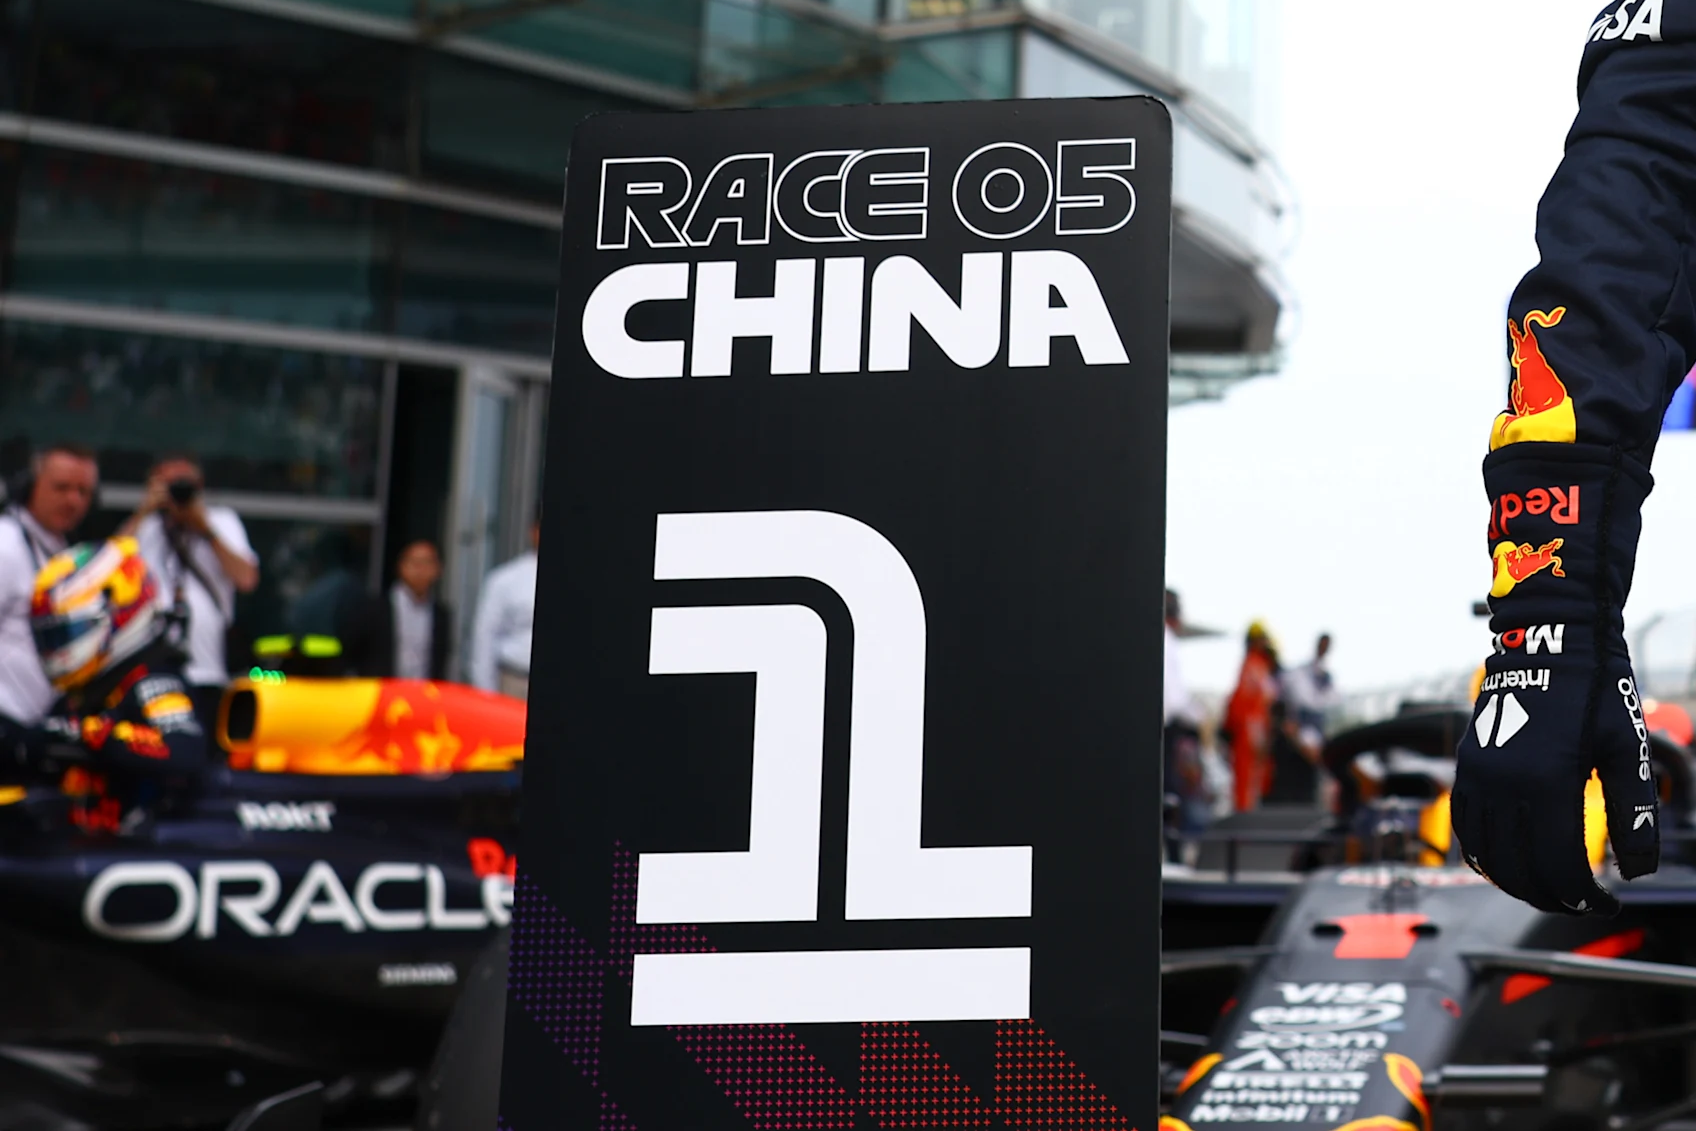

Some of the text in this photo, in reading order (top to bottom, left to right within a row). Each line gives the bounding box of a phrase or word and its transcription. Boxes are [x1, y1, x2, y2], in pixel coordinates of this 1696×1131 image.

[597, 137, 1137, 250] RACE 05
[581, 249, 1131, 380] CHINA
[630, 509, 1033, 1027] 1
[1618, 677, 1651, 782] sparco
[83, 860, 515, 942] ORACLE
[1276, 982, 1407, 1004] VISA
[1235, 1031, 1389, 1049] zoom
[1189, 1105, 1310, 1122] Mobil
